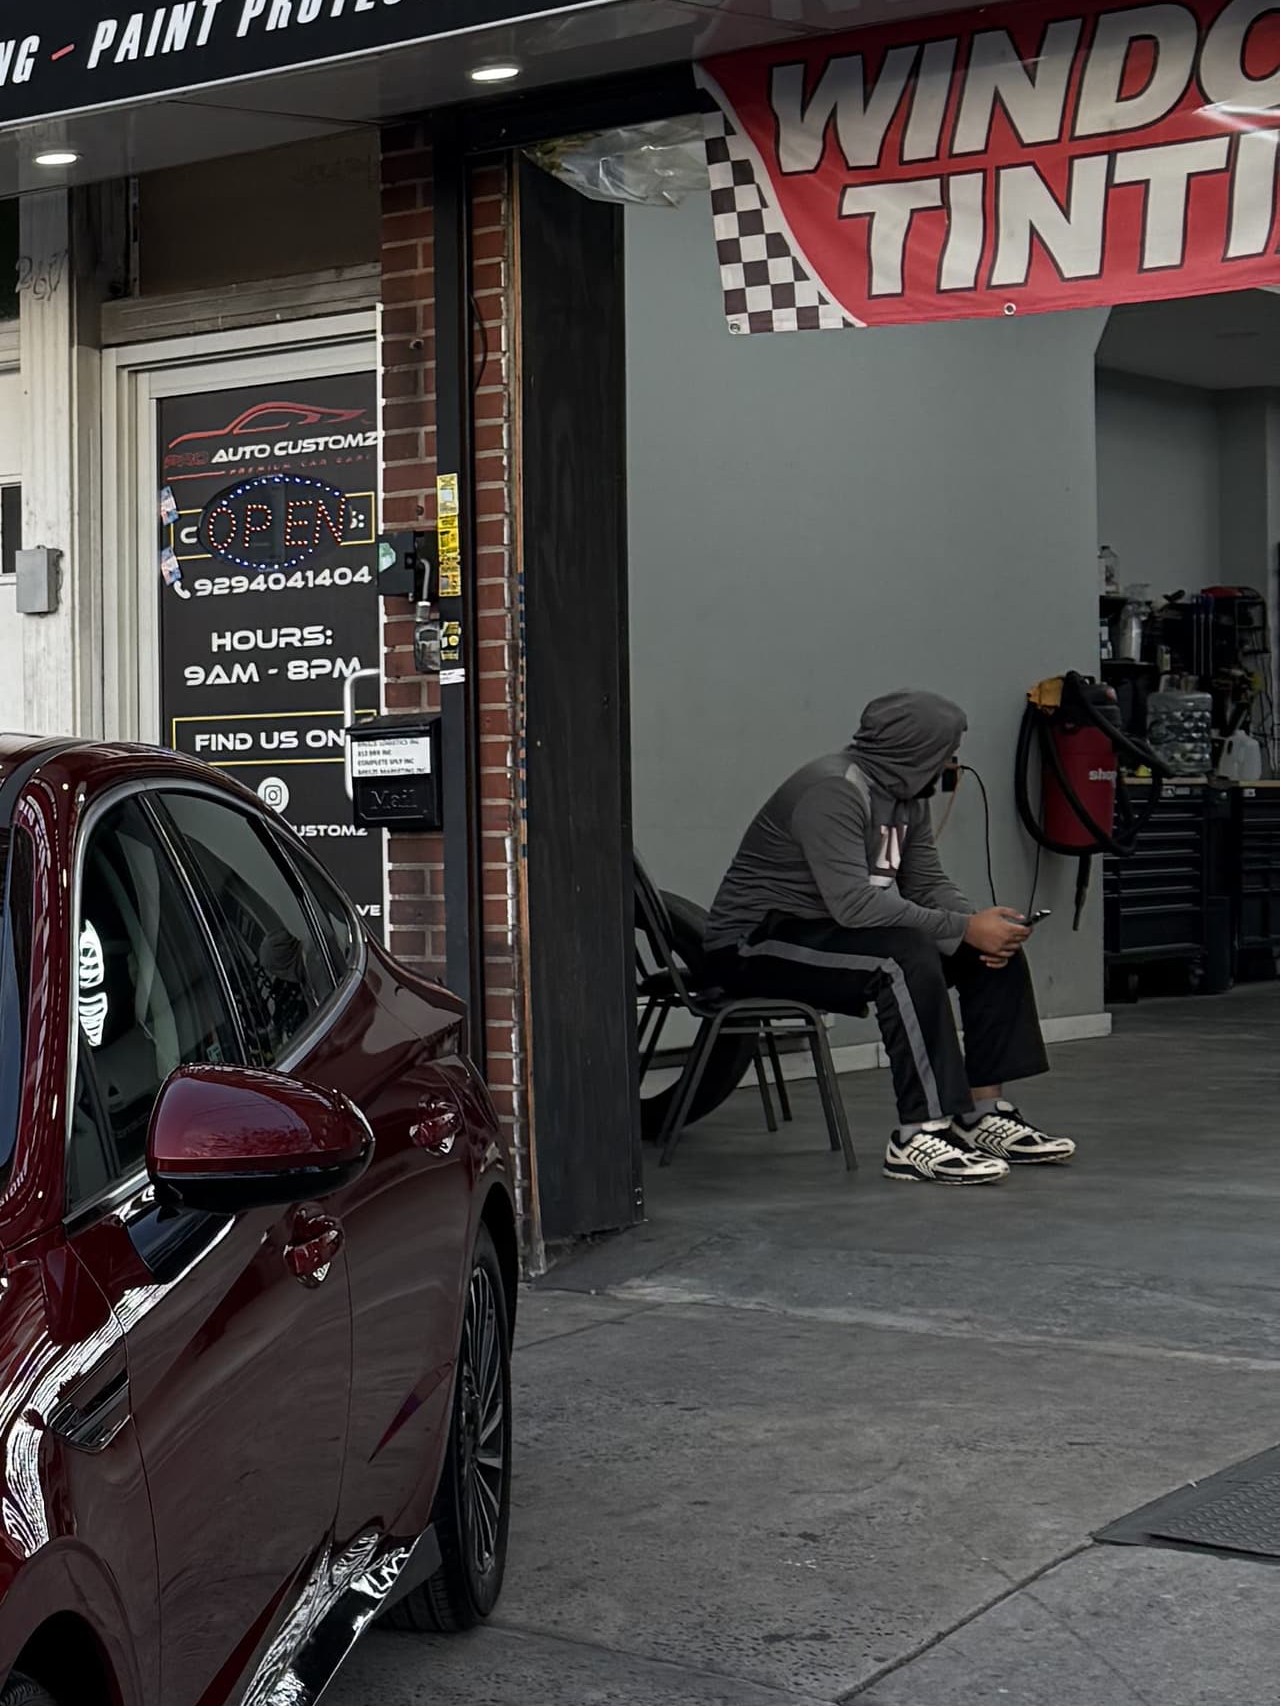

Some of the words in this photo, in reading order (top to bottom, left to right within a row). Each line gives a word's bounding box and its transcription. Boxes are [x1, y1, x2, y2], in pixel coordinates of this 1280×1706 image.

[211, 444, 271, 464] AUTO
[273, 431, 378, 457] CUSTOMZ
[207, 497, 347, 550] OPEN
[194, 565, 373, 597] 9294041404
[211, 625, 333, 652] HOURS:
[184, 661, 260, 686] 9AM
[287, 656, 361, 681] 8PM
[195, 732, 253, 752] FIND
[260, 730, 299, 749] US
[305, 728, 345, 748] ON
